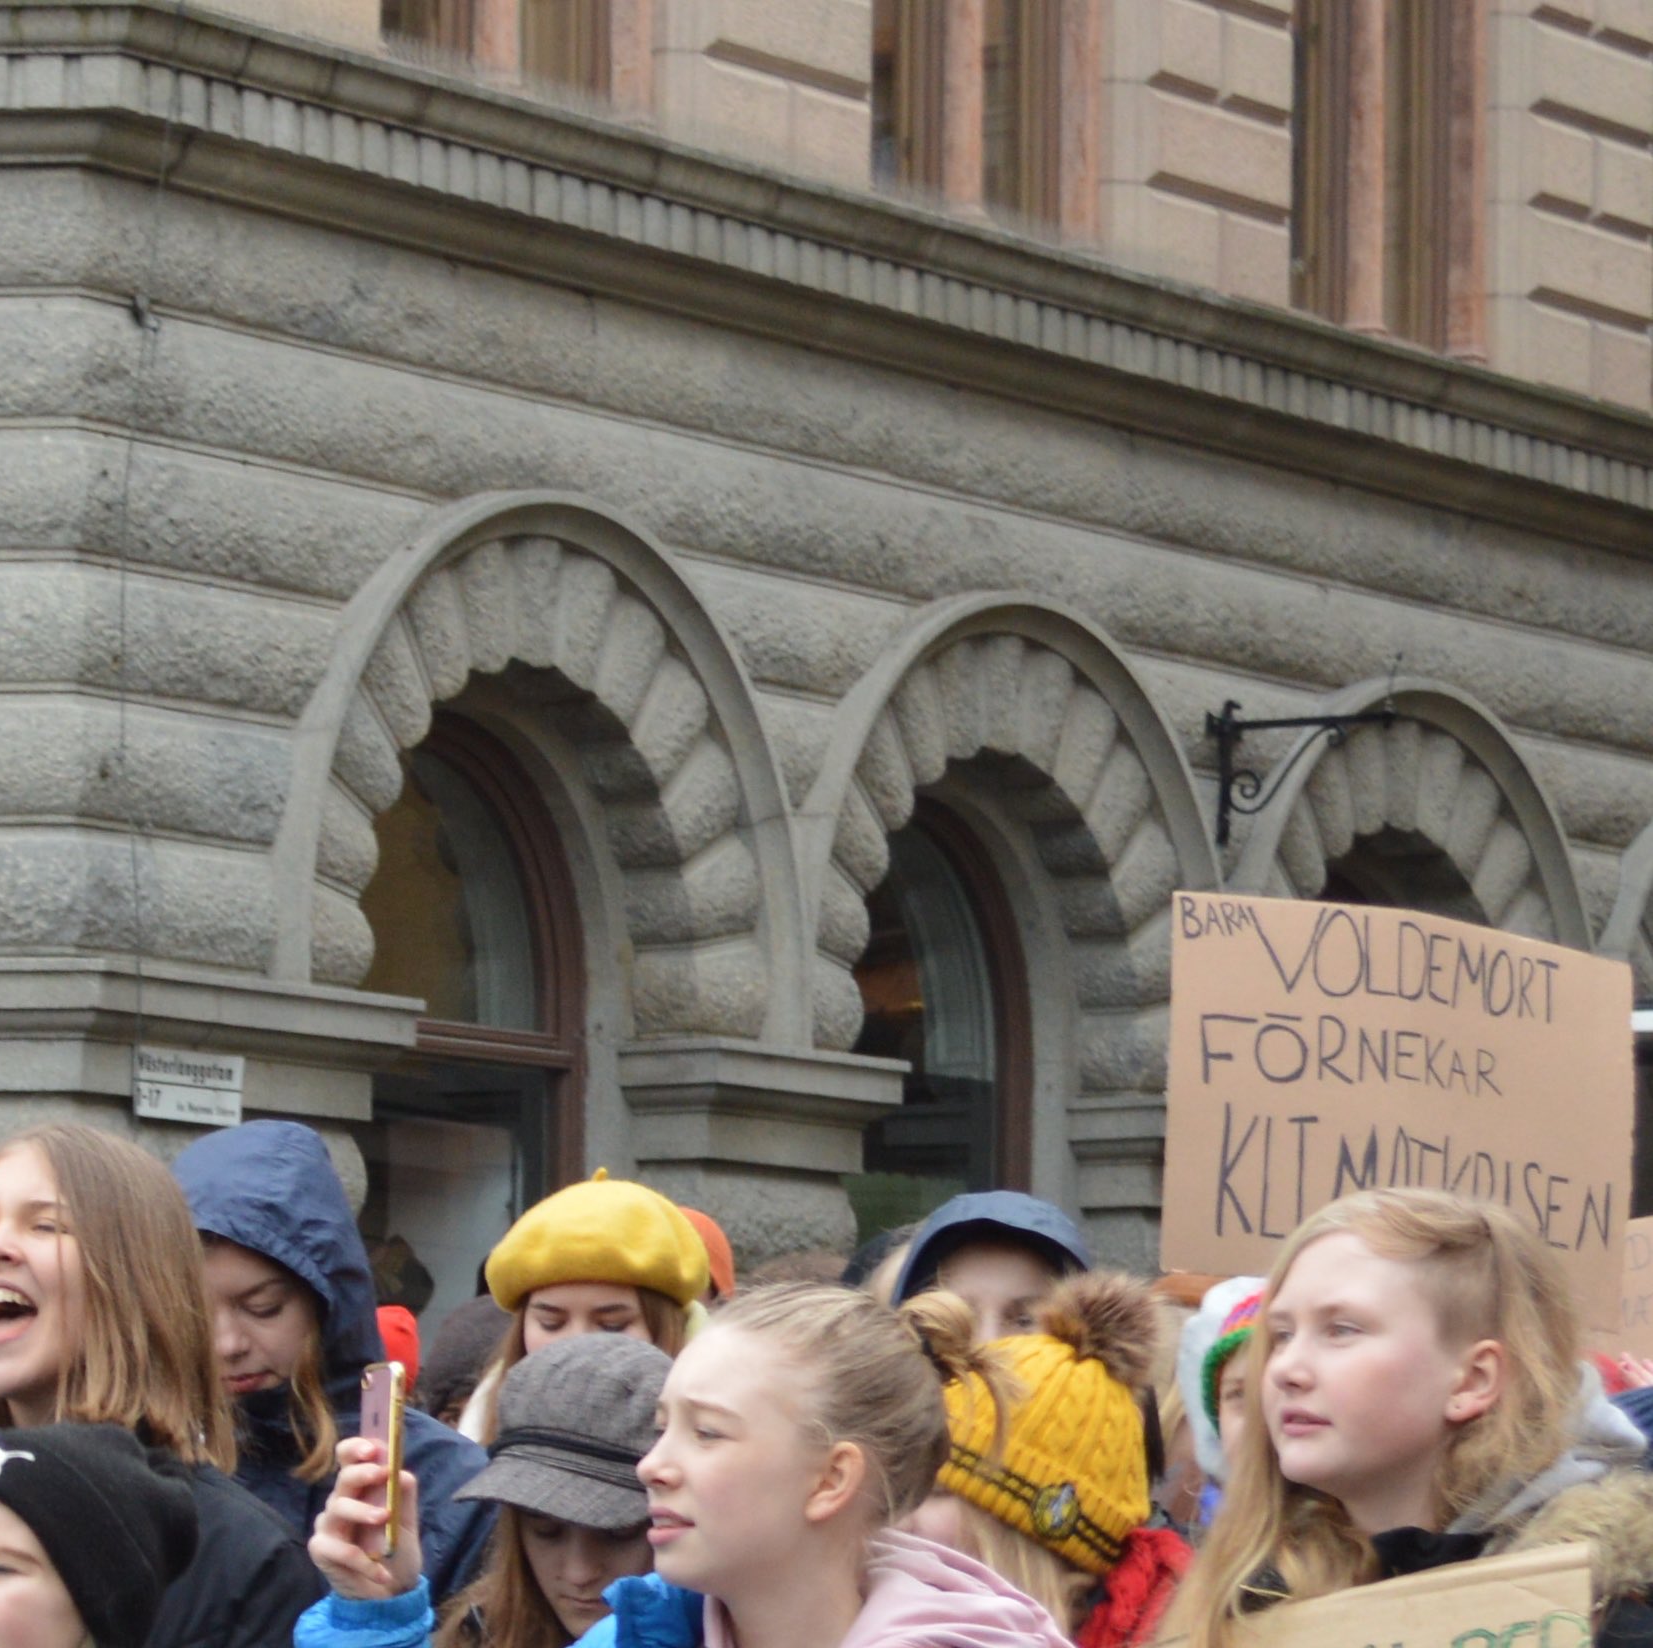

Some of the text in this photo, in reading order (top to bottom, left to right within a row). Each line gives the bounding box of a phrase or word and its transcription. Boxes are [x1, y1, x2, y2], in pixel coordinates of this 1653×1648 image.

[1181, 895, 1560, 1024] BARA VOLDEMORT
[1200, 1012, 1502, 1097] FÖRNEKAR
